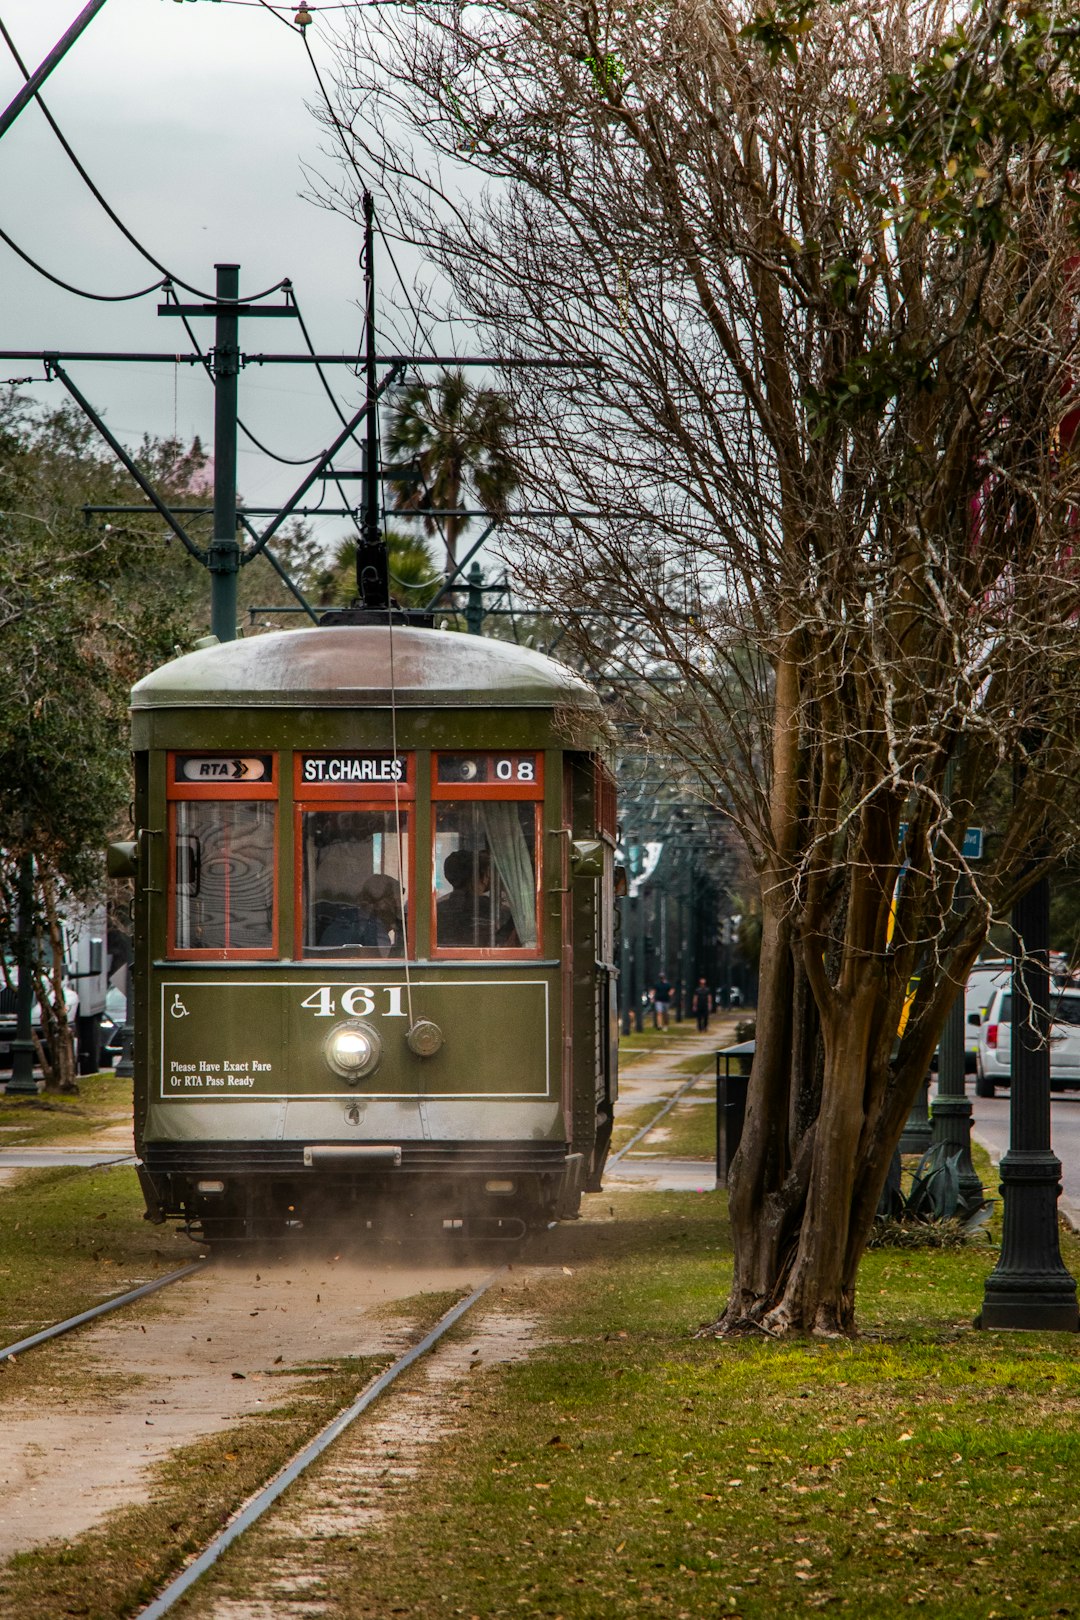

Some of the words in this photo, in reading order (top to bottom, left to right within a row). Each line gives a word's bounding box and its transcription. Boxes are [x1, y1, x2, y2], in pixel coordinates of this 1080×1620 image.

[200, 763, 228, 776] RTA
[497, 760, 534, 781] 08
[301, 987, 407, 1017] 461
[170, 1061, 196, 1072] Please
[199, 1061, 220, 1072] Have
[223, 1061, 249, 1072] Exact
[252, 1061, 272, 1072] Fare
[170, 1076, 182, 1086] Or
[184, 1076, 203, 1086] RTA
[206, 1076, 225, 1086] Pass
[227, 1075, 254, 1087] Ready
